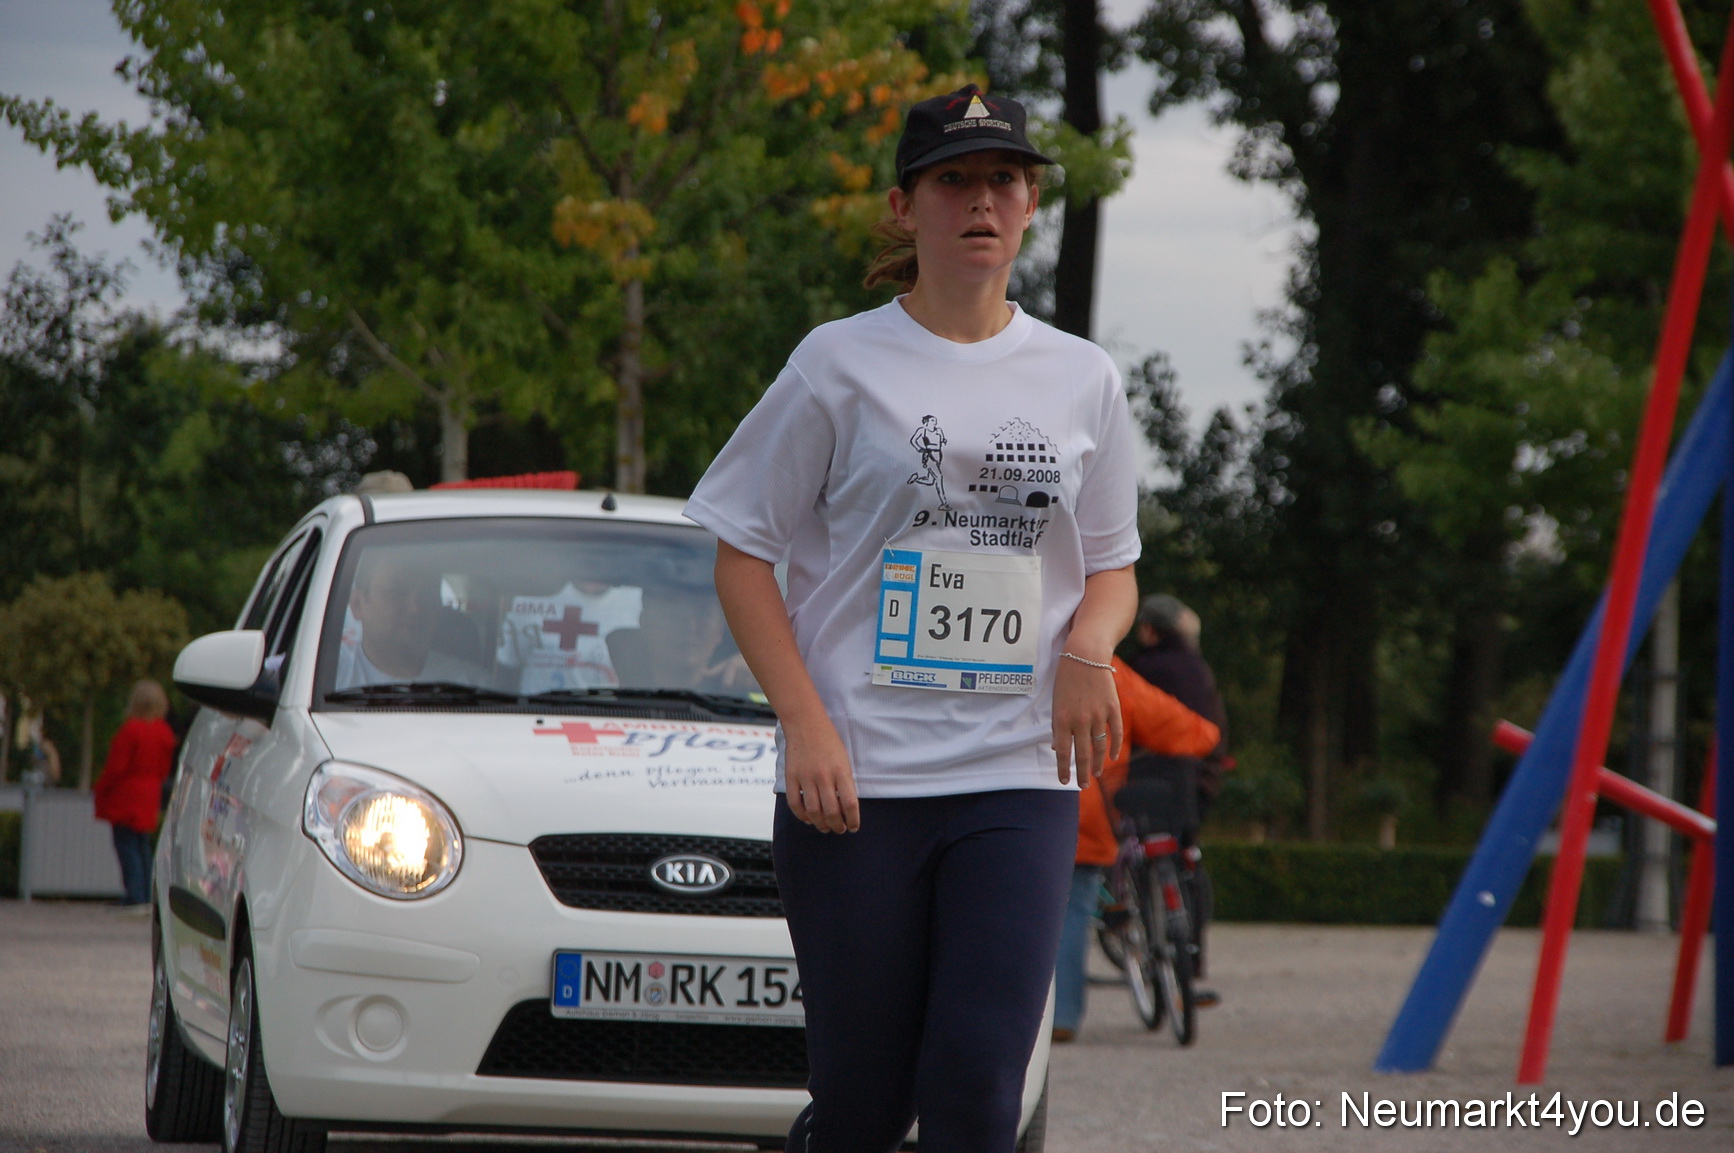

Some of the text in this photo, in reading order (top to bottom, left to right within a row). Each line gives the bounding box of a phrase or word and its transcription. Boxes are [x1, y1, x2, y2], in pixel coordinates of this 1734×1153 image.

[979, 467, 1061, 483] 21.09.2008
[912, 510, 1049, 533] 9. Neumarktr
[970, 529, 1044, 549] Stadtlaf
[929, 563, 964, 590] Eva
[889, 599, 899, 617] D
[928, 605, 1022, 645] 3170
[891, 669, 936, 682] BOCK
[978, 672, 1032, 686] PFLEIDERER
[665, 861, 717, 885] KIA
[562, 984, 573, 999] D
[584, 960, 642, 1003] NM
[670, 964, 727, 1006] RK
